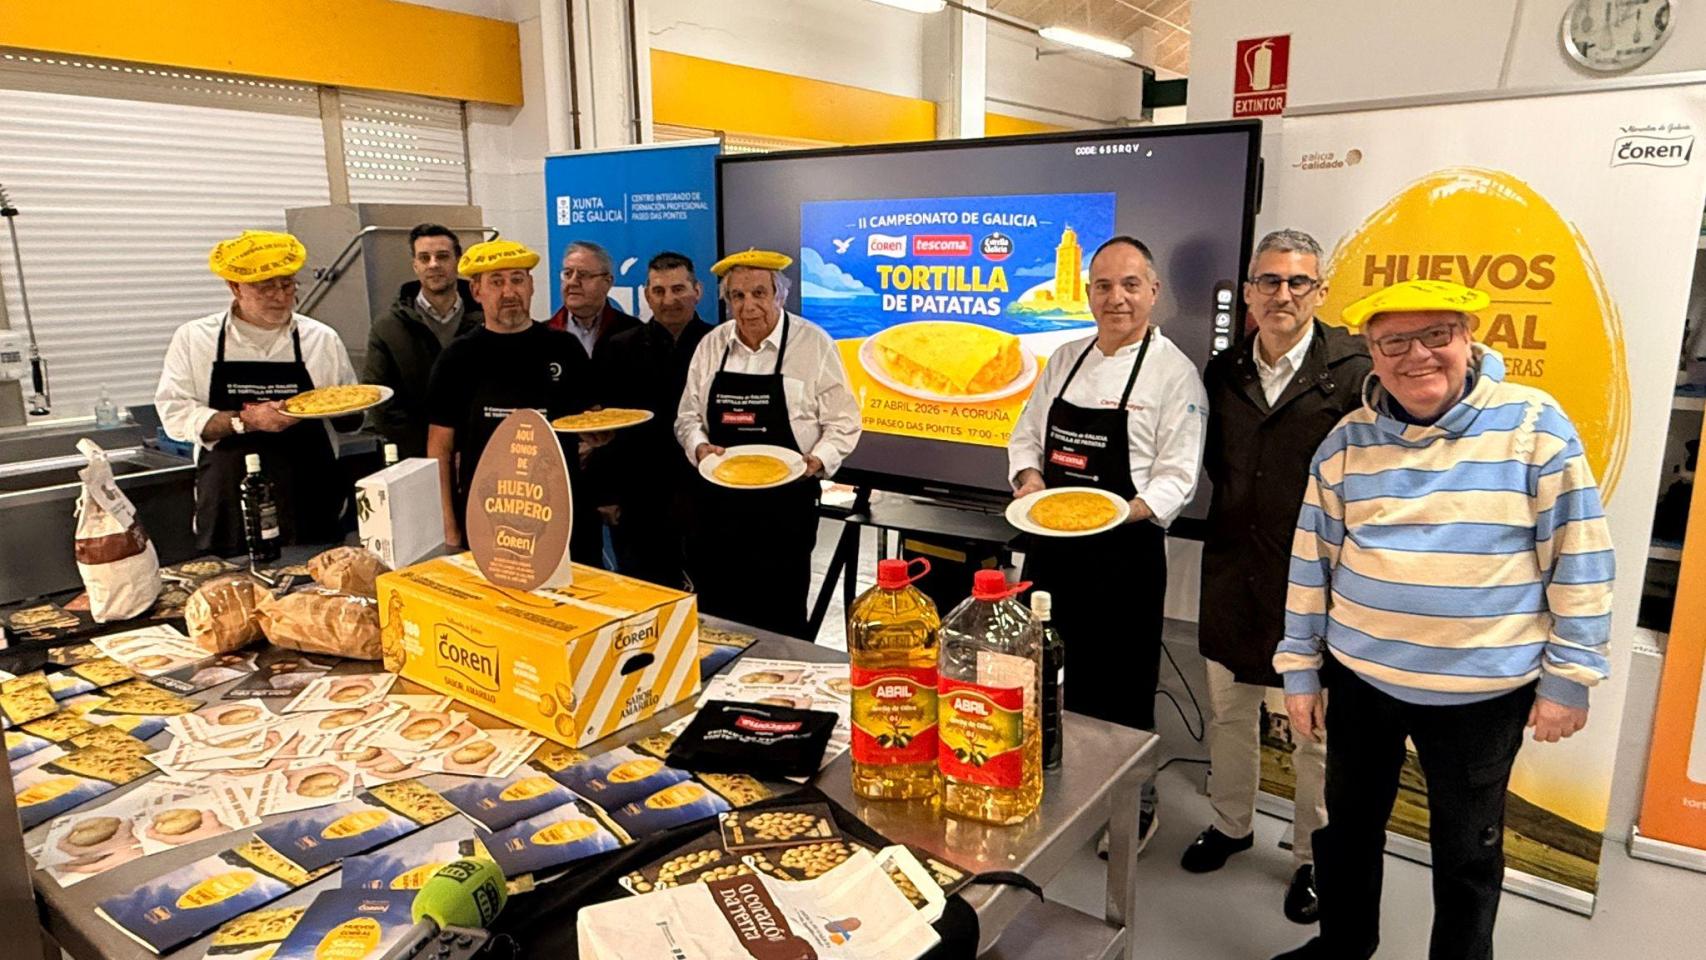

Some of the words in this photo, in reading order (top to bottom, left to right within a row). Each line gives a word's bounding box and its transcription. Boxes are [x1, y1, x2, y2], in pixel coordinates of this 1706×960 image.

[1235, 97, 1283, 113] EXTINTOR
[1301, 160, 1344, 170] calidade
[1302, 152, 1334, 162] galicia
[572, 198, 604, 209] XUNTA
[632, 193, 655, 202] CENTRO
[656, 192, 691, 201] INTEGRADO
[692, 191, 701, 200] DE
[666, 201, 708, 210] PROFESIONAL
[572, 212, 585, 223] DE
[587, 210, 623, 223] GALICIA
[632, 212, 649, 220] PASEO
[650, 212, 662, 220] DAS
[663, 211, 687, 219] PONTES
[858, 217, 867, 229] II
[869, 212, 959, 228] CAMPEONATO
[961, 212, 980, 225] DE
[982, 213, 1038, 227] GALICIA
[876, 265, 1009, 293] TORTILLA
[1362, 254, 1555, 290] HUEVOS
[882, 294, 908, 312] DE
[911, 295, 1000, 316] PATATAS
[870, 399, 881, 409] 27
[883, 400, 911, 412] ABRIL
[914, 403, 940, 415] 2026
[951, 407, 960, 417] A
[961, 408, 1010, 422] CORUÑA
[862, 416, 875, 425] IFP
[876, 418, 905, 429] PASEO
[906, 421, 924, 432] DAS
[926, 423, 962, 436] PONTES
[516, 429, 534, 441] AQUÍ
[511, 444, 537, 456] SOMOS
[517, 457, 528, 469] DE
[497, 480, 543, 500] HUEVO
[485, 498, 552, 522] CAMPERO
[444, 676, 463, 692] SABOR
[466, 686, 496, 704] AMARILLO
[626, 690, 652, 706] SABOR
[876, 686, 912, 698] ABRIL
[619, 695, 659, 719] AMARILLO
[953, 698, 988, 715] ABRIL
